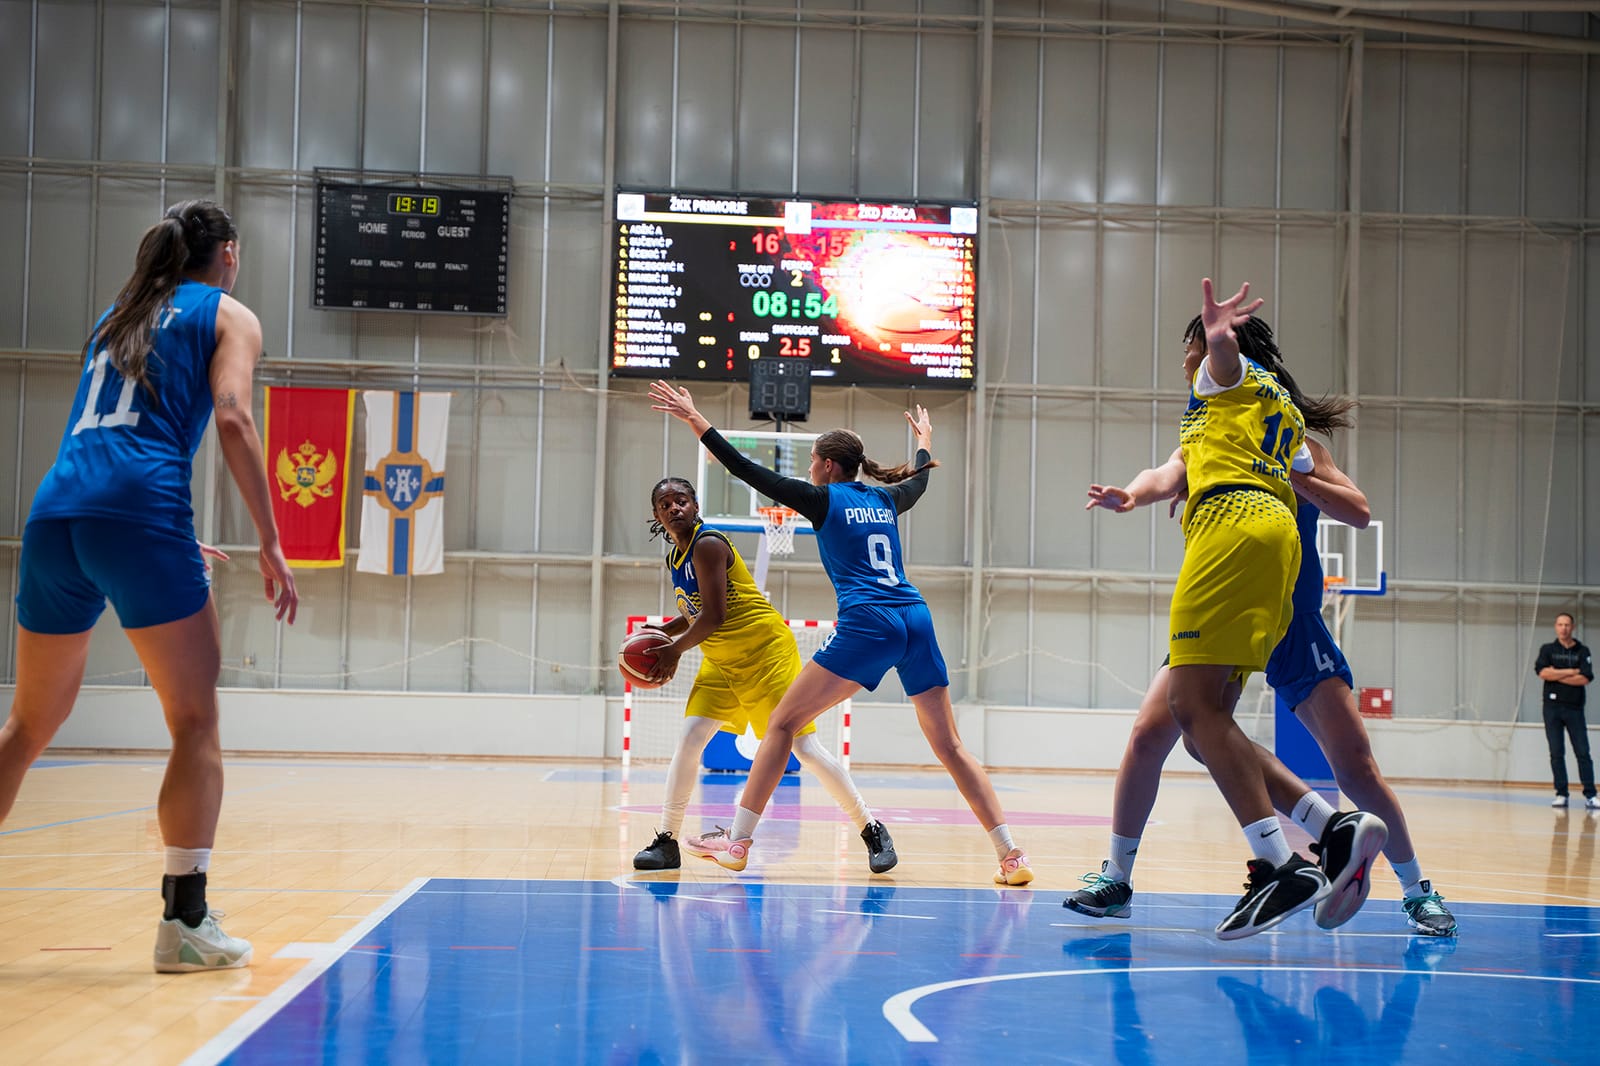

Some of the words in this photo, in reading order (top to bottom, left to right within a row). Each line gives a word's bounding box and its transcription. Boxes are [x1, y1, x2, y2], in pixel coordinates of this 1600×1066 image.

[692, 199, 748, 215] PRIMORJE
[358, 221, 389, 235] HOME
[401, 230, 427, 240] PERIOD
[437, 225, 471, 239] GUEST
[729, 241, 736, 251] 2
[752, 232, 779, 255] 16
[817, 236, 845, 258] 15
[790, 269, 804, 287] 2
[752, 291, 839, 319] 08:54
[748, 344, 760, 361] 0
[779, 336, 812, 357] 2.5
[830, 347, 842, 363] 1
[72, 350, 140, 436] 11
[867, 533, 900, 587] 9
[1310, 641, 1335, 673] 4
